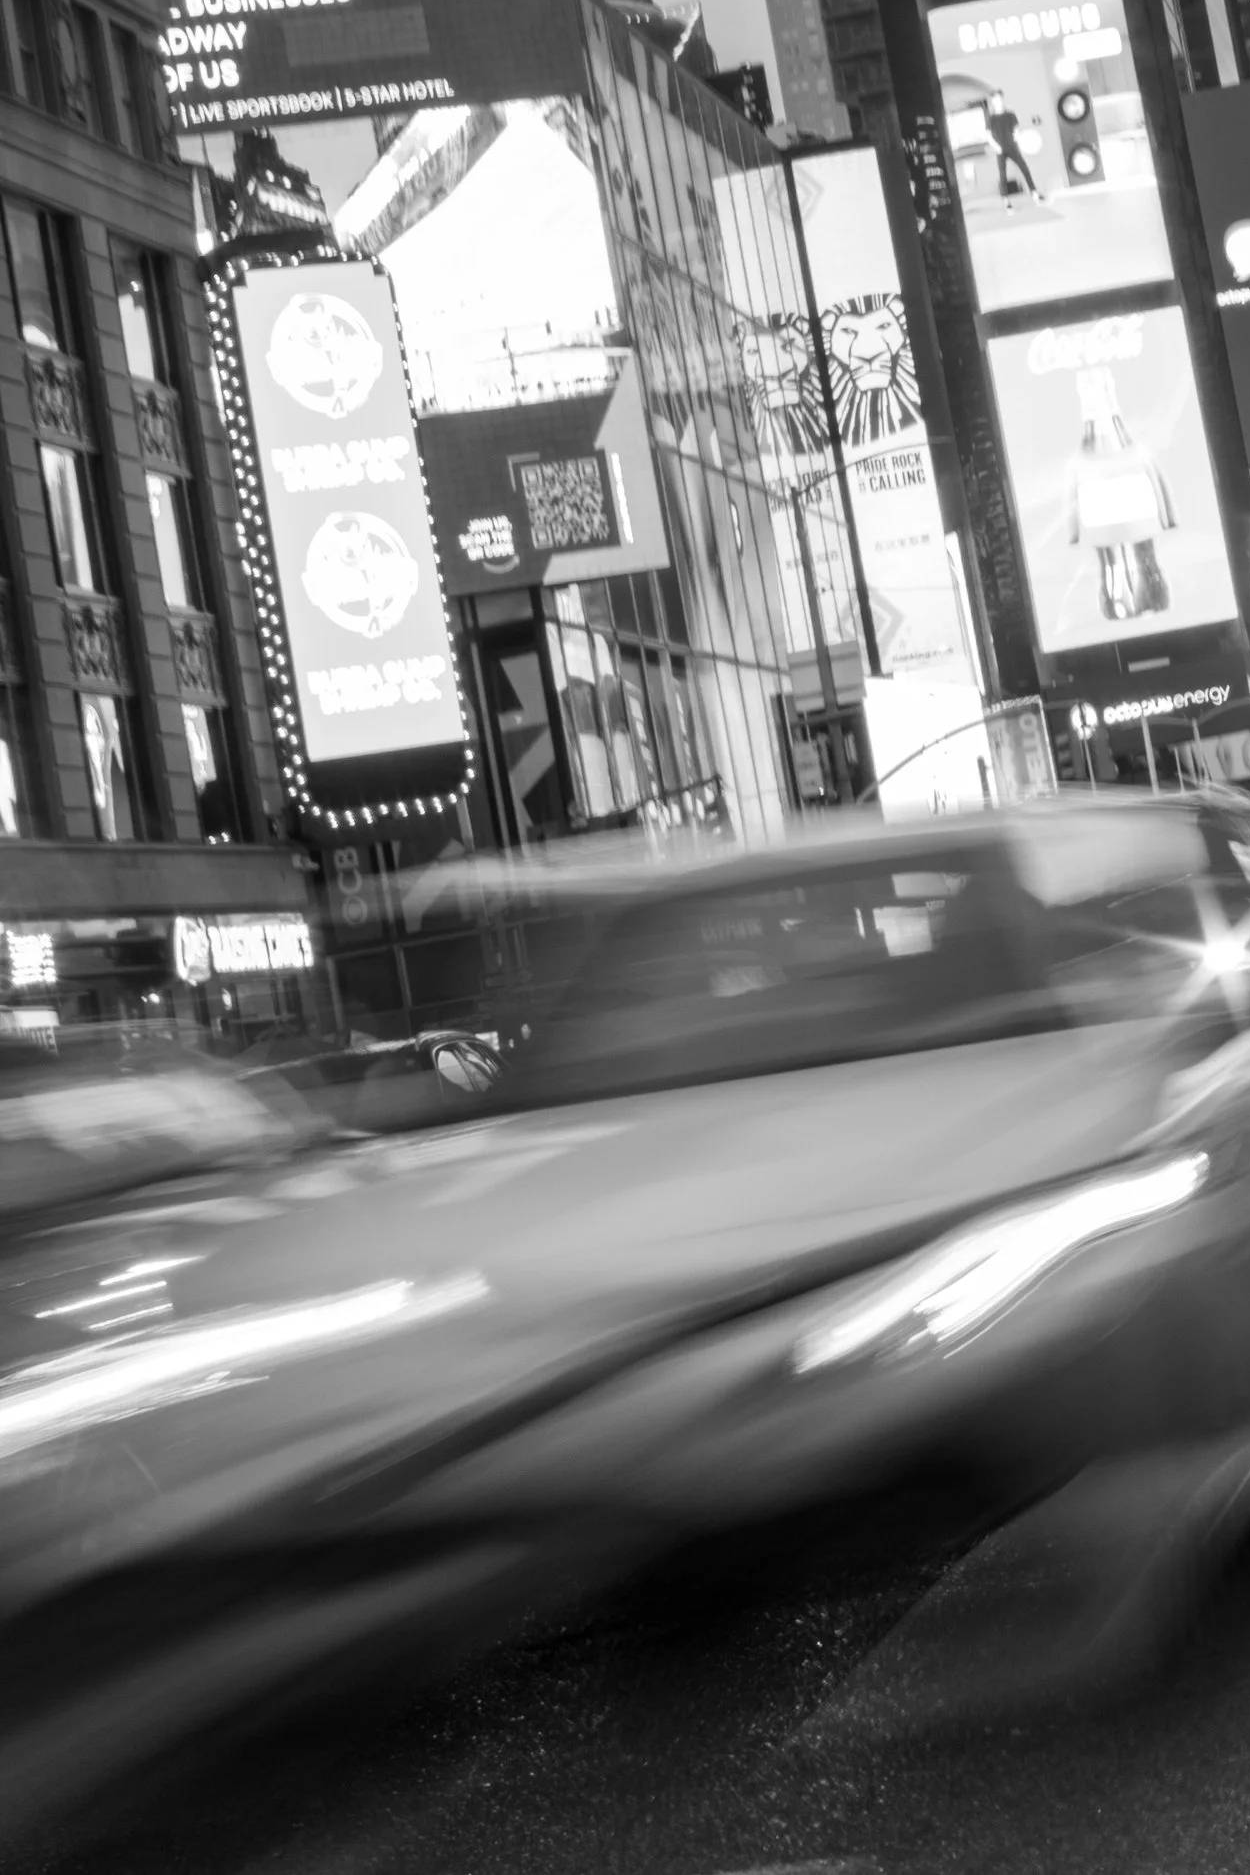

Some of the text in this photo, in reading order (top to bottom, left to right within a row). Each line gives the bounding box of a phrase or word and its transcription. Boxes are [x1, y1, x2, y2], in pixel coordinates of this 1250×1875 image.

[199, 58, 240, 90] US
[189, 101, 225, 125] LIVE
[226, 90, 335, 121] SPORTSBOOK
[344, 82, 401, 109] 5-STAR
[402, 77, 456, 102] HOTEL
[855, 451, 923, 475] PRIDE ROCK
[869, 469, 927, 493] CALLING
